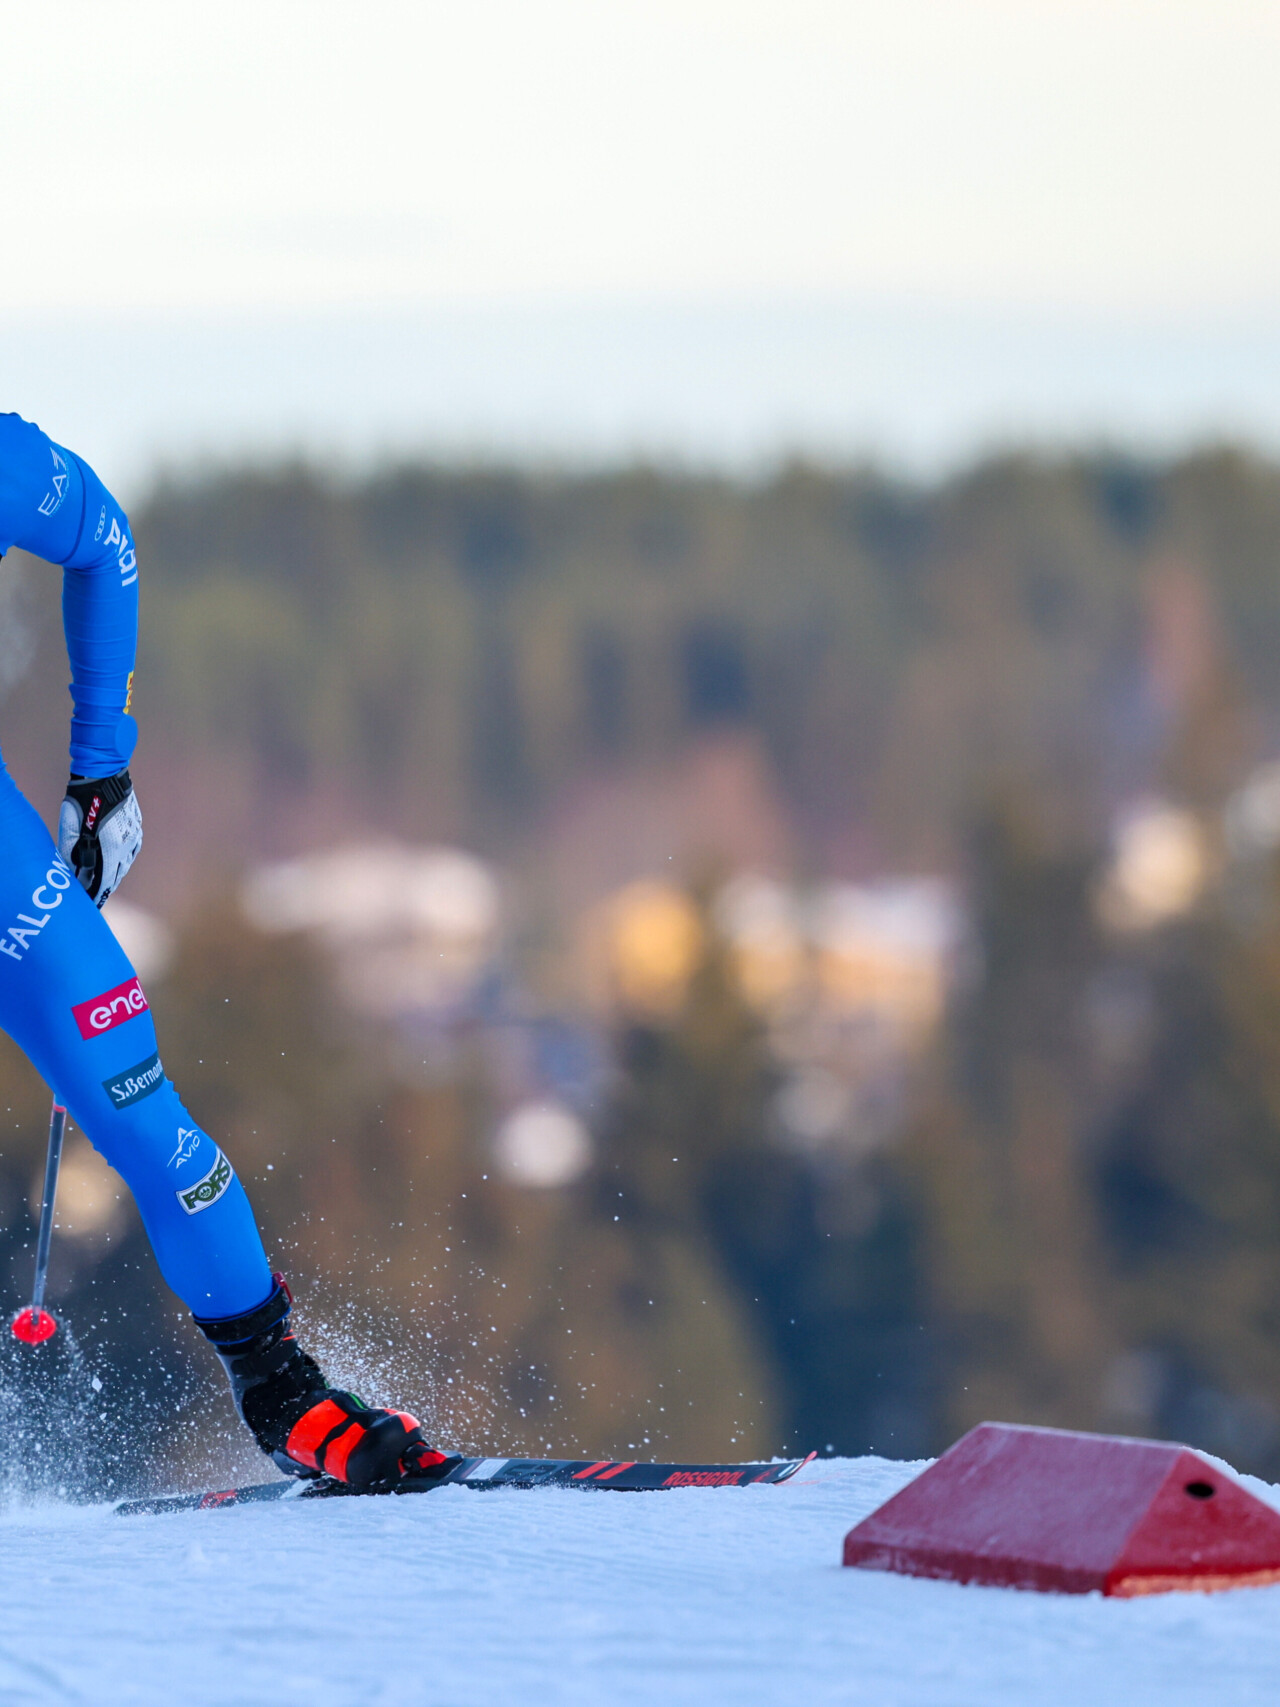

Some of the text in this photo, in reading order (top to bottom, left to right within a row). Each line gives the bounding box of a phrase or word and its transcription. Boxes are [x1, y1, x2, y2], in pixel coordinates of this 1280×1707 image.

[89, 979, 148, 1030] enel
[176, 1135, 201, 1170] AVIO
[662, 1471, 747, 1486] ROSSIGNOL
